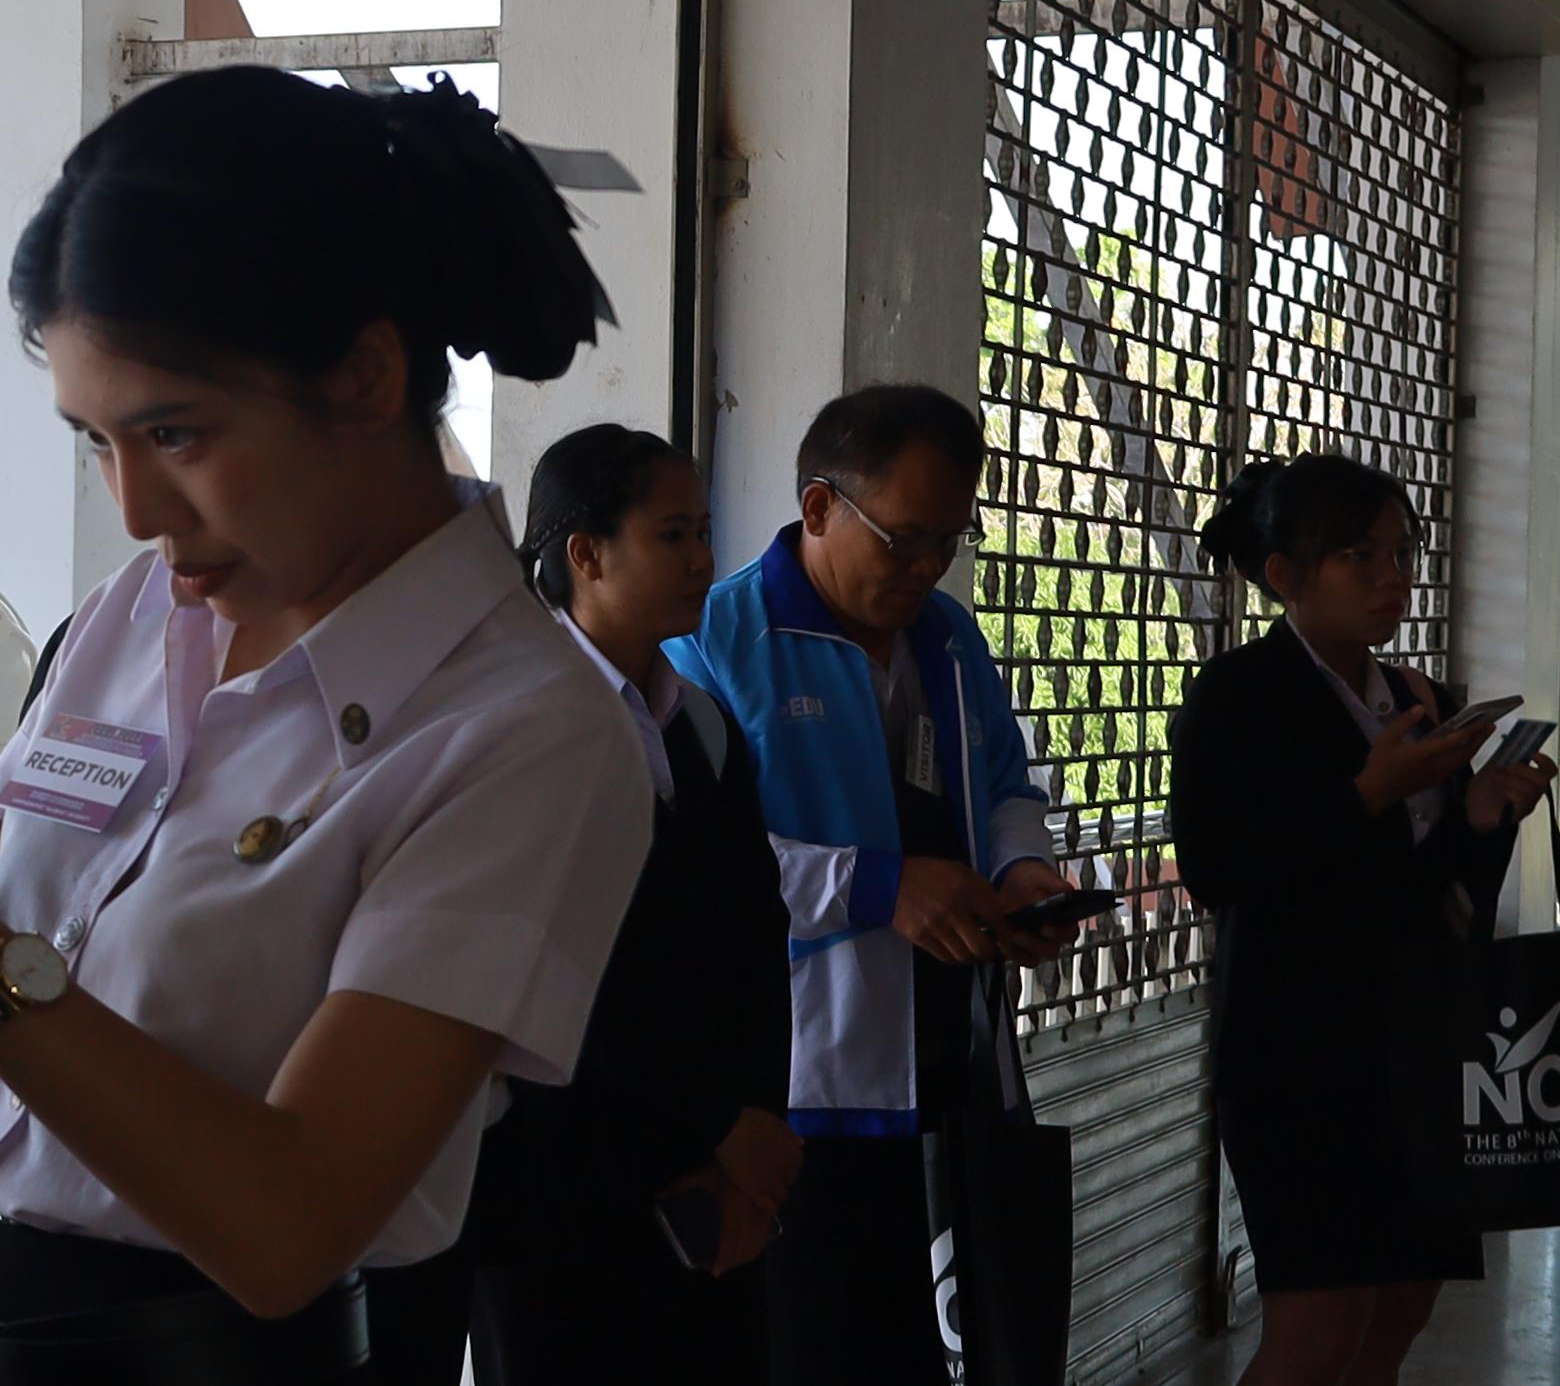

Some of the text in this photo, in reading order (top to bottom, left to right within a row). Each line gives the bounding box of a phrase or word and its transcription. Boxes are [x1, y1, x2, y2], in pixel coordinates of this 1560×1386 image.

[25, 751, 132, 790] RECEPTION
[1464, 1133, 1501, 1150] THE
[1464, 1152, 1540, 1166] CONFERENCE
